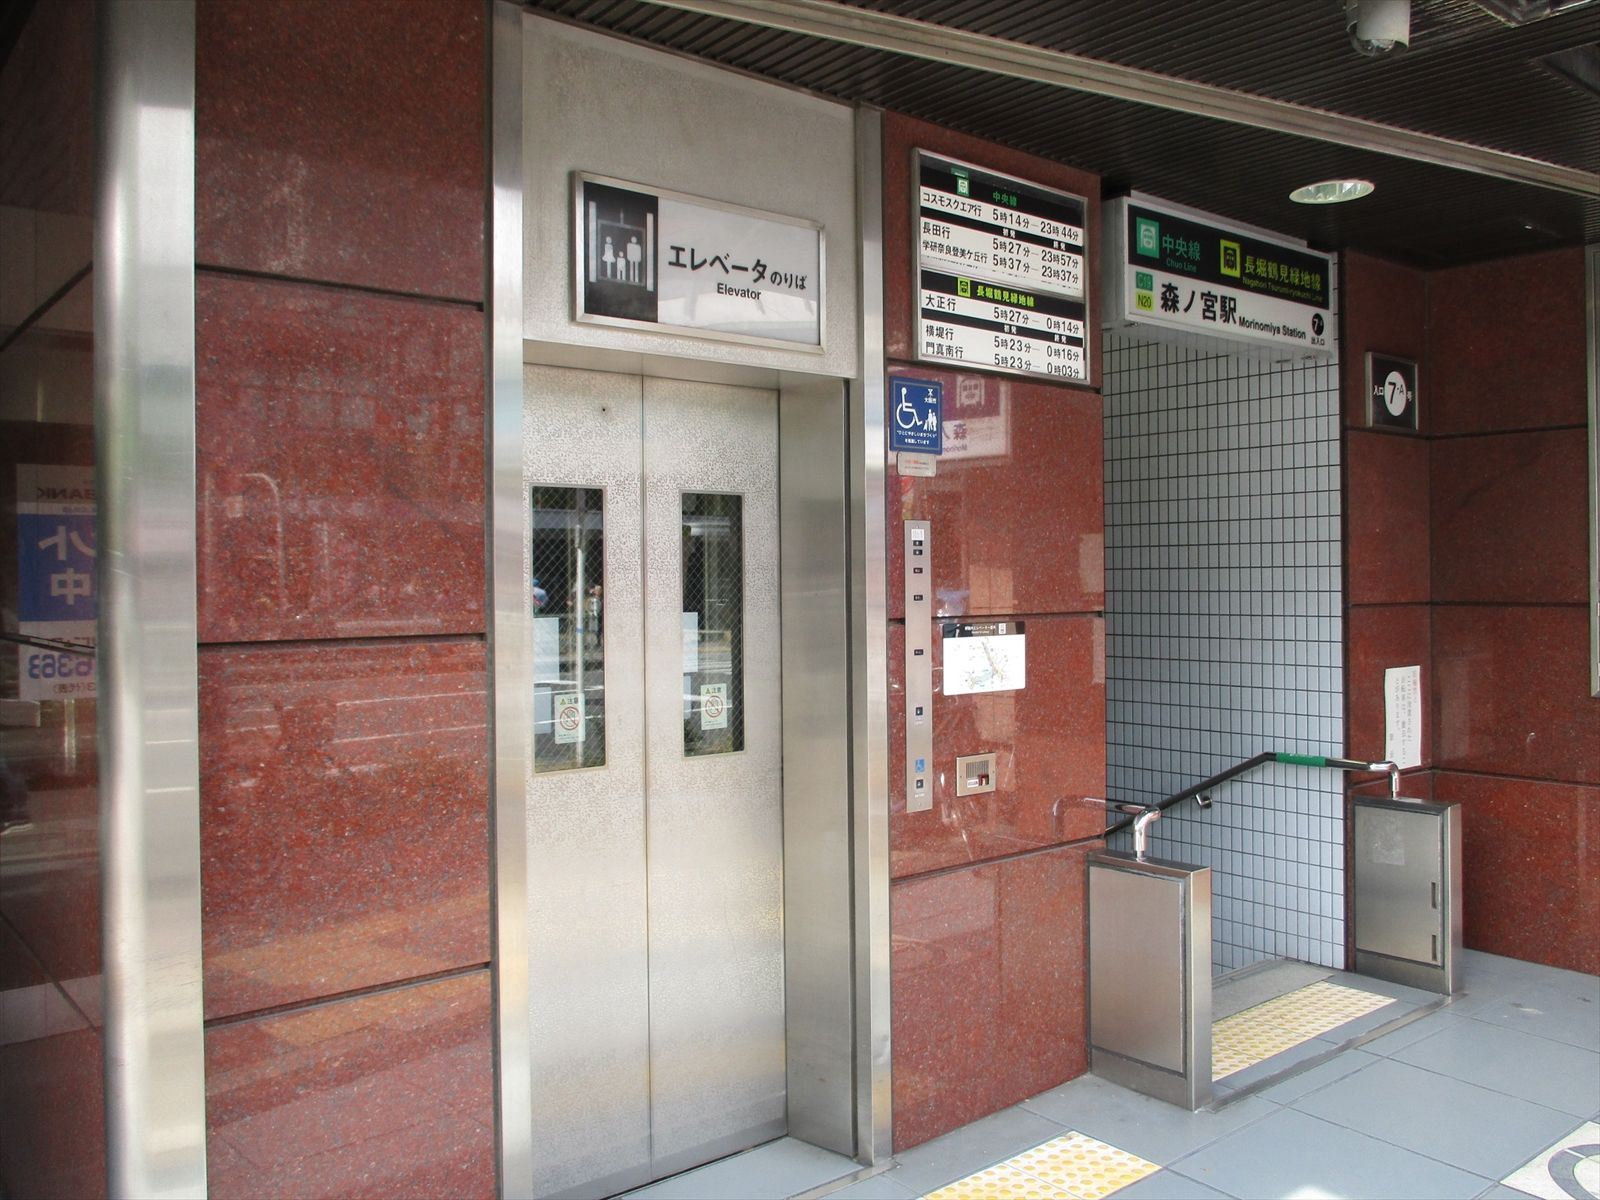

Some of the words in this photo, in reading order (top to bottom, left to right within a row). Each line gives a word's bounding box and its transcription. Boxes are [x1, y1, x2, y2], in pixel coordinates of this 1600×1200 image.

[923, 192, 982, 217] コスモスクエア行
[992, 191, 1017, 207] 中央線
[922, 221, 951, 240] 長田行
[1162, 233, 1201, 261] 中央線
[1245, 255, 1321, 291] 長堀鶴見緑地線
[1166, 258, 1182, 270] Chuo
[1184, 261, 1197, 272] Line
[717, 282, 762, 301] Elevator
[925, 293, 957, 312] 大正行
[1137, 294, 1152, 309] N20
[1160, 282, 1237, 324] 森ノ宮駅
[925, 324, 954, 341] 横堤行
[1239, 315, 1280, 336] Morinomiya
[1282, 324, 1307, 340] Station
[925, 341, 964, 359] 門真南行
